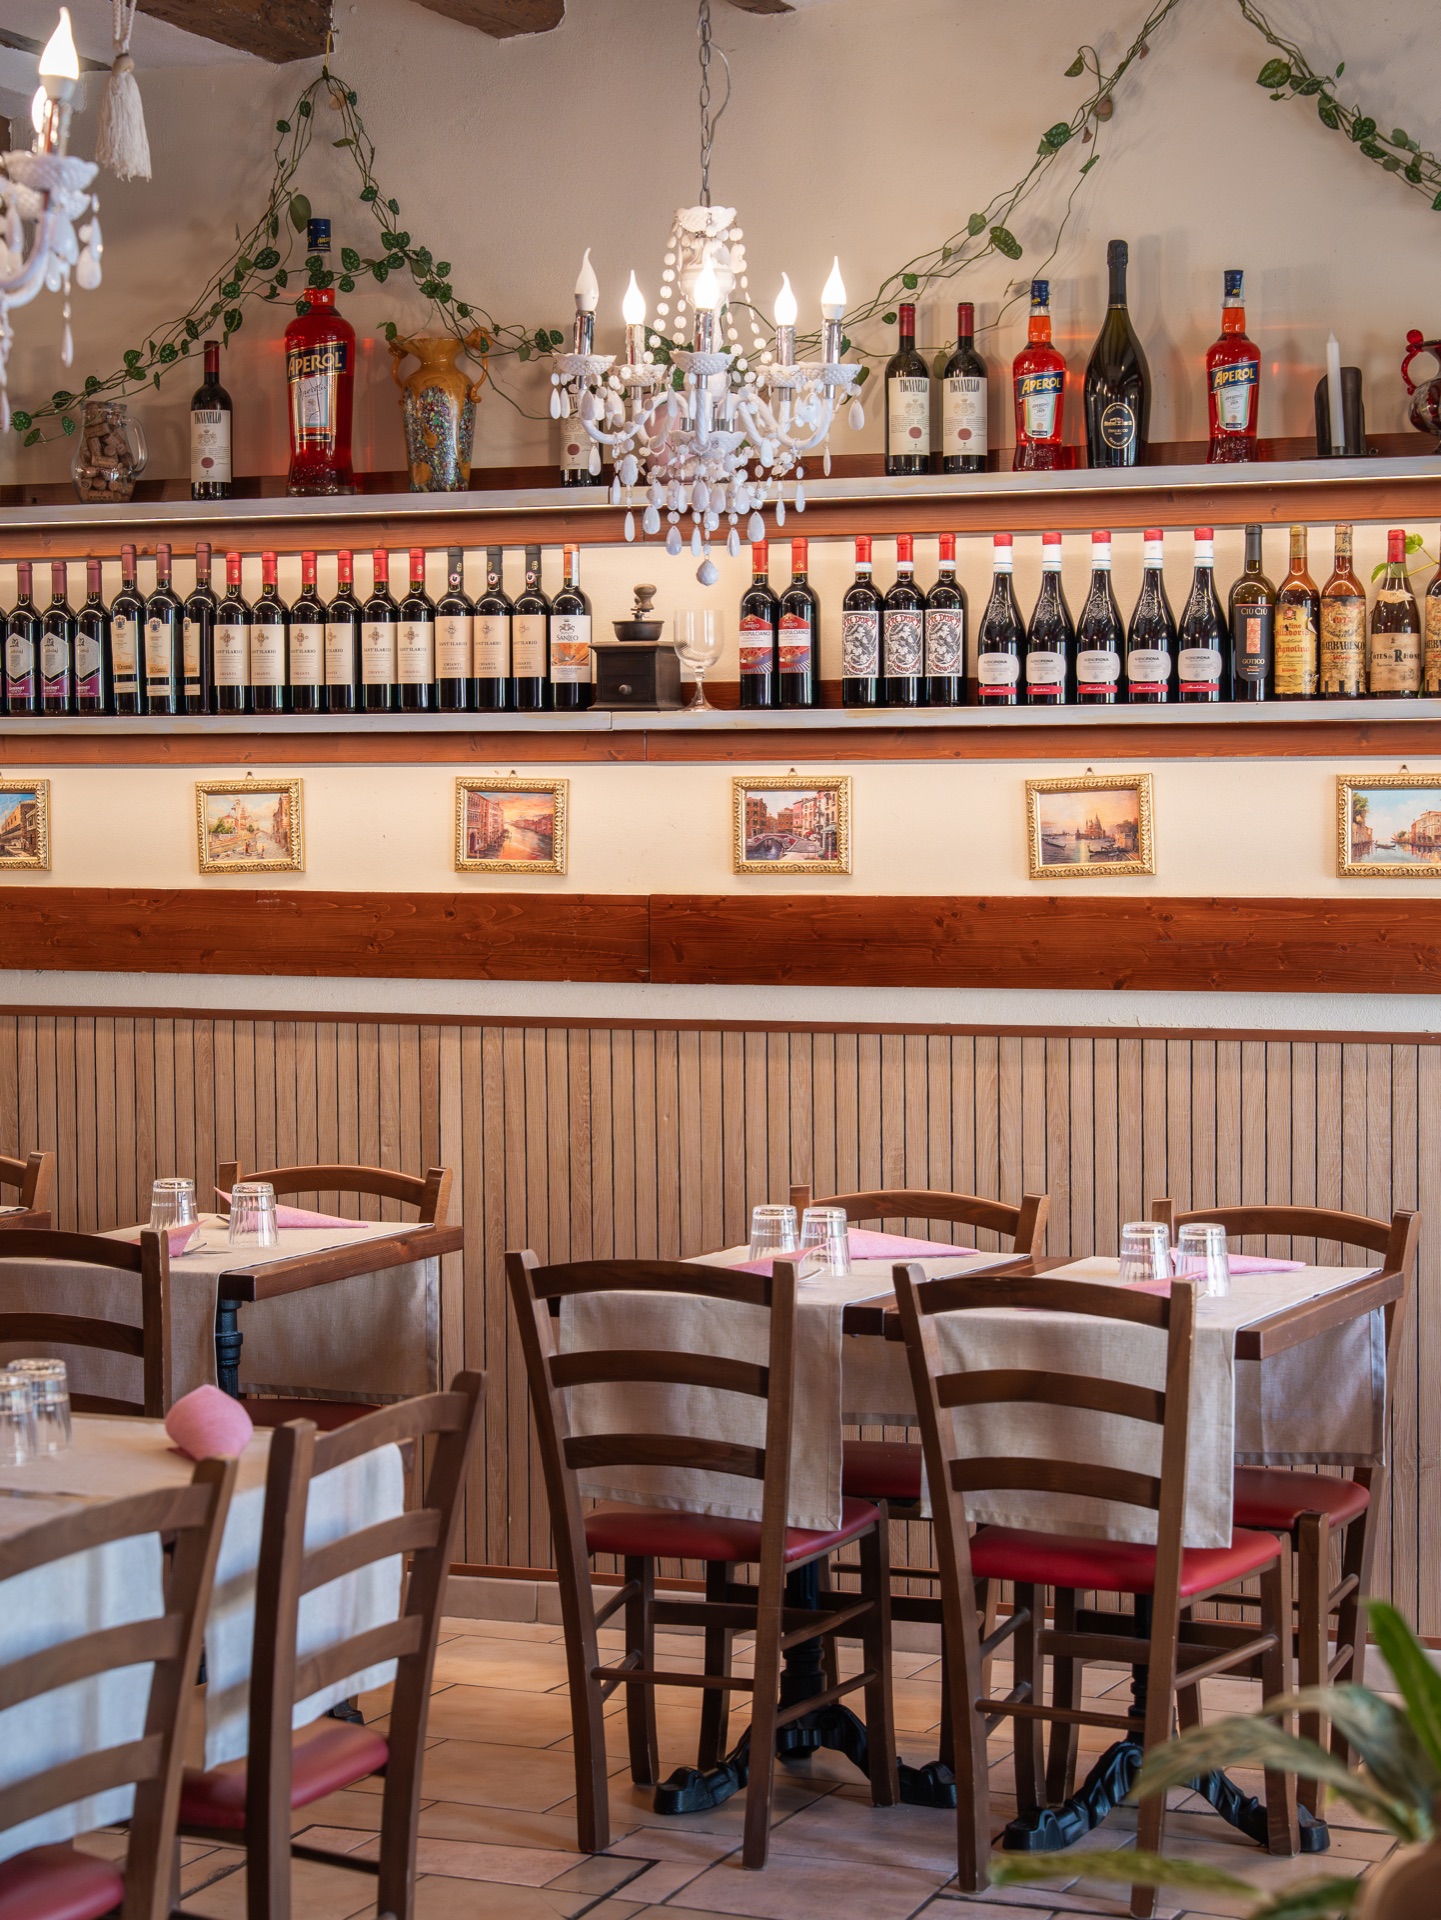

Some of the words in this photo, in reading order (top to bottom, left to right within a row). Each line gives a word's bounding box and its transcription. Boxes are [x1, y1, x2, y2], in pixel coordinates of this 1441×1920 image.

[288, 351, 342, 377] APEROL
[1214, 367, 1255, 388] APEROL
[900, 379, 928, 393] TIGNANELLO
[950, 379, 980, 393] TIGNANELLO
[1022, 377, 1061, 395] APEROL
[1241, 607, 1254, 616] CIÙ
[1254, 607, 1268, 616] CIÙ
